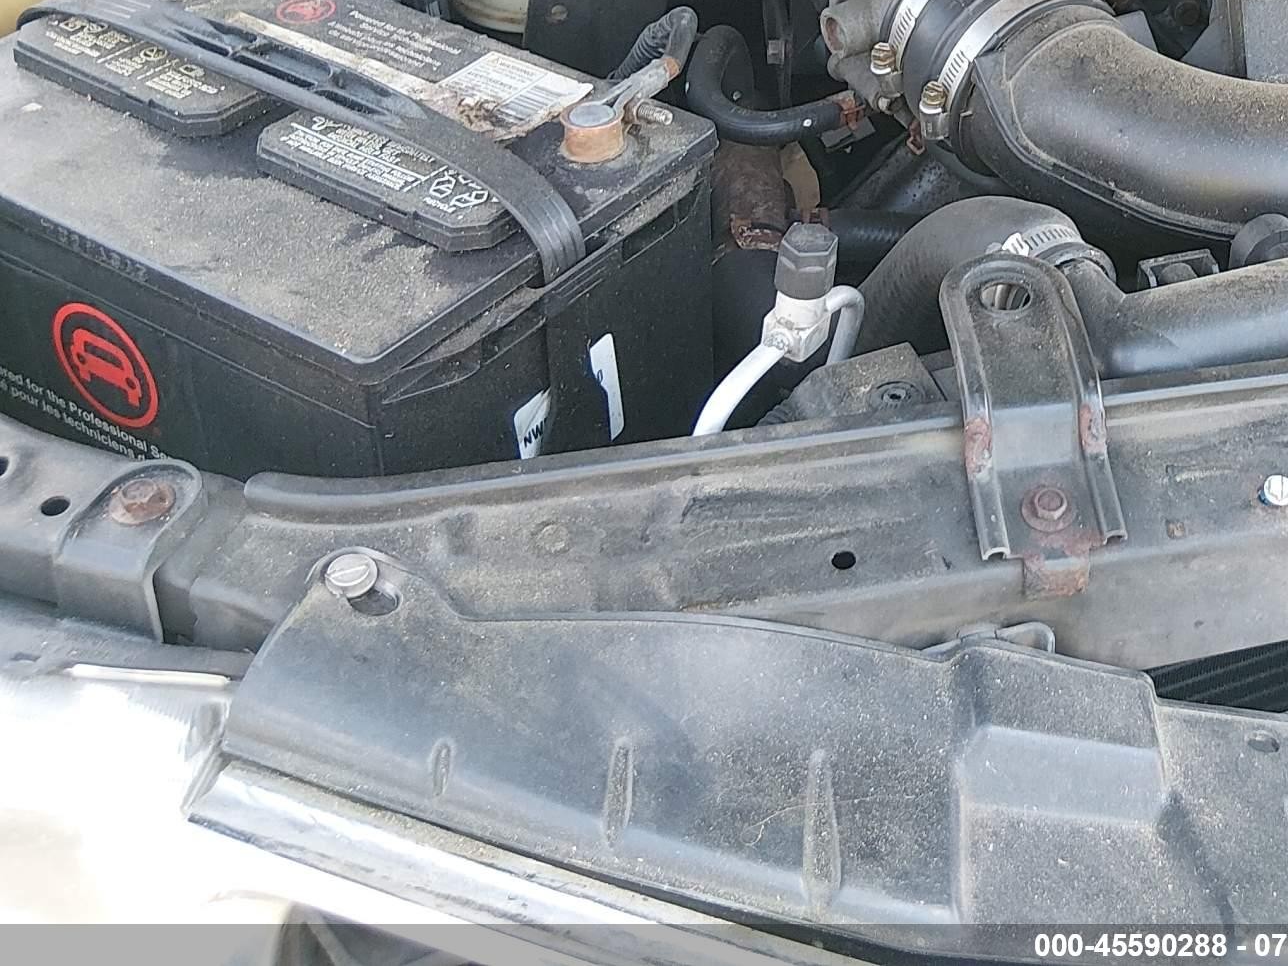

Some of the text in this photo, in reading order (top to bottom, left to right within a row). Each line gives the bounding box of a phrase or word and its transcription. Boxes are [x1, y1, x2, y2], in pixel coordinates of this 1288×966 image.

[11, 386, 135, 460] pour les techniciens
[26, 377, 44, 395] for
[47, 389, 67, 409] the
[69, 401, 148, 453] Professional
